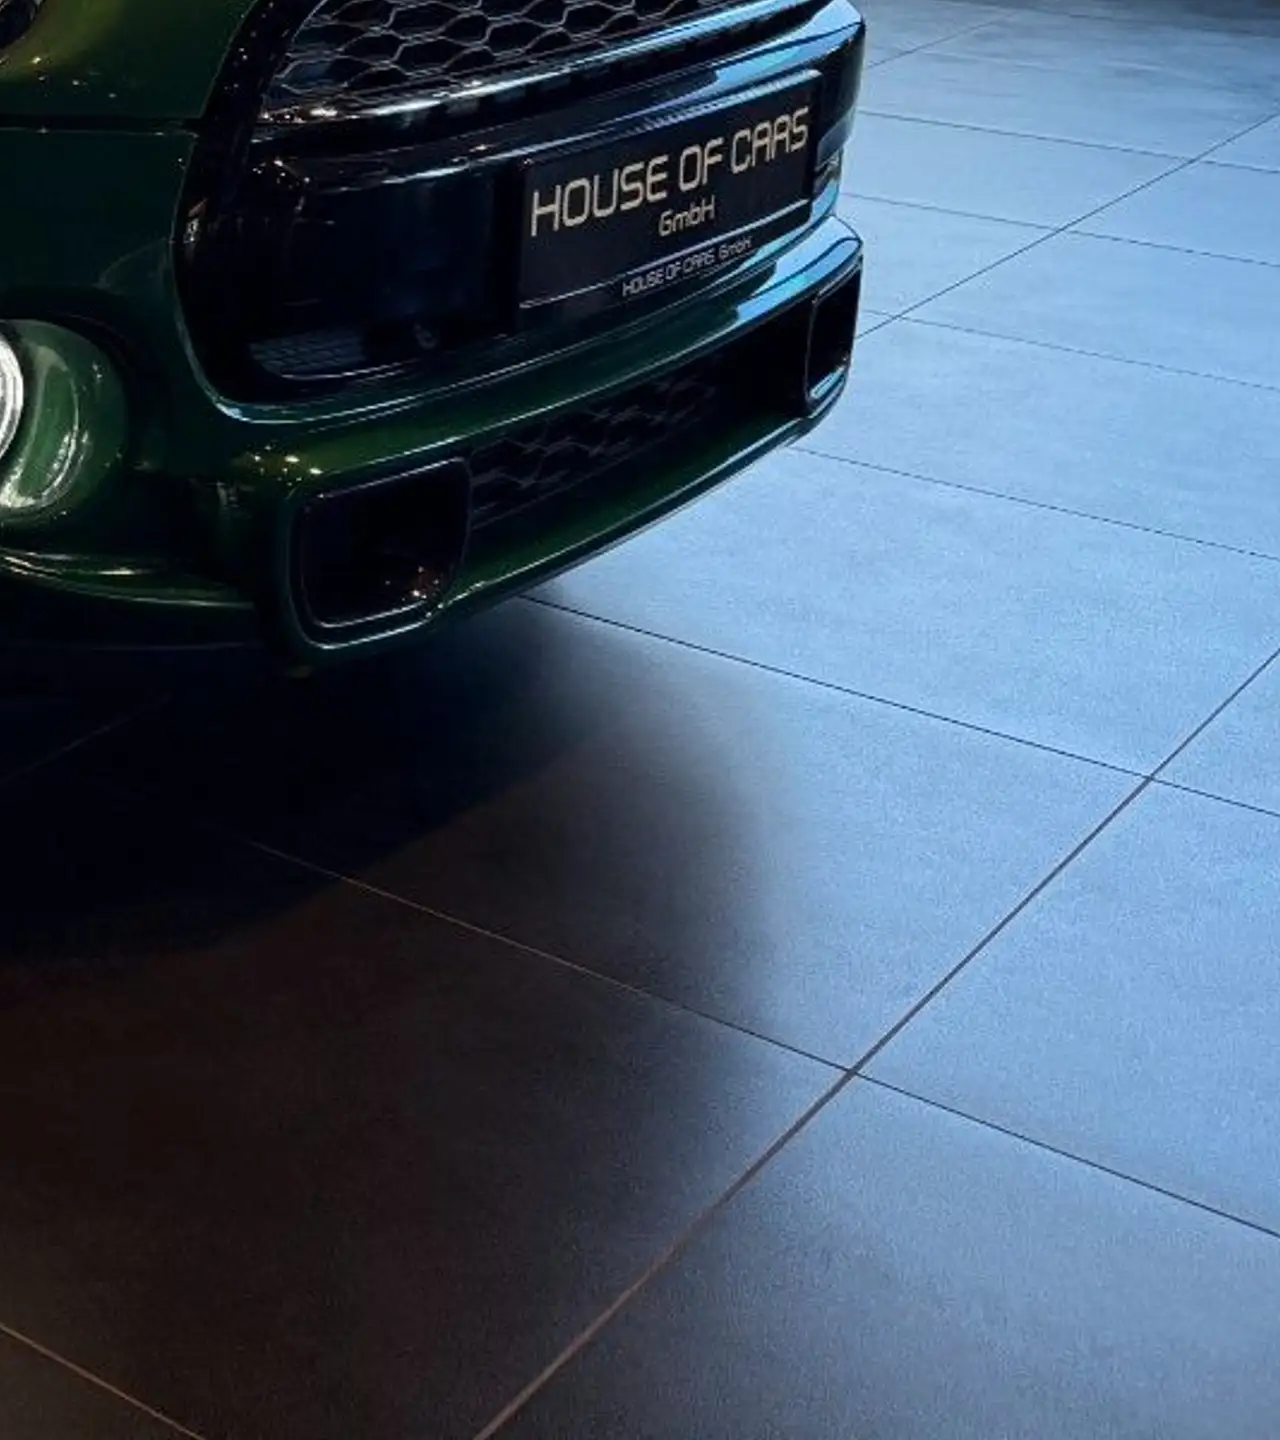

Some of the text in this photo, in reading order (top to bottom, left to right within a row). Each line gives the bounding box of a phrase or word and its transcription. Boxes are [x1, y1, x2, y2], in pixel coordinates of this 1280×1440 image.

[530, 106, 810, 237] HOUSE OF CARS
[657, 195, 716, 237] GmbH
[621, 268, 665, 298] HOUSE
[665, 261, 682, 280] OF
[718, 236, 753, 260] GmbH
